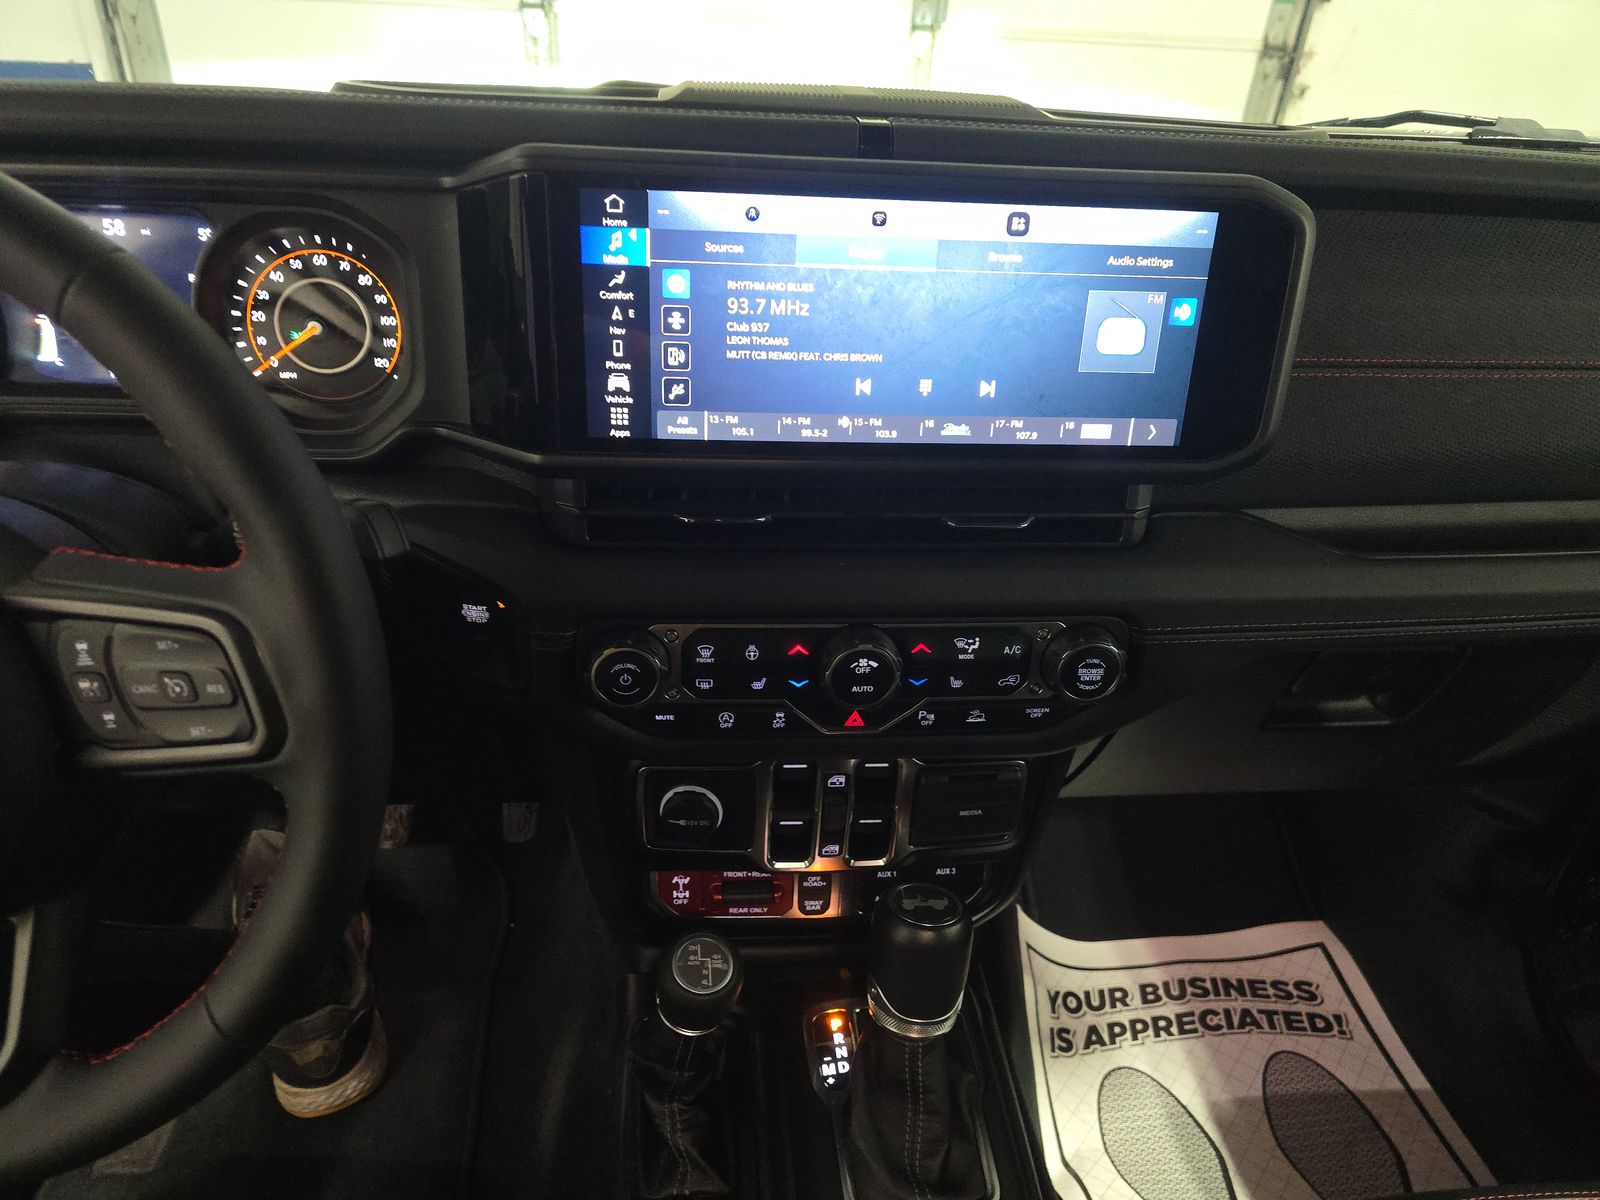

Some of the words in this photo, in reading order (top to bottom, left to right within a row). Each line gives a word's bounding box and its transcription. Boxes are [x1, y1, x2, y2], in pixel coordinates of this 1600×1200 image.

[602, 217, 628, 227] Home
[102, 218, 126, 237] 58
[704, 242, 744, 254] Sources
[288, 258, 303, 270] 50
[312, 254, 328, 266] 60
[1107, 255, 1135, 267] Audio
[1136, 256, 1174, 269] Settings
[338, 260, 351, 271] 70
[268, 270, 284, 283] 40
[358, 273, 372, 286] 80
[766, 282, 786, 292] AND
[256, 290, 270, 300] 30
[374, 294, 388, 304] 90
[599, 290, 634, 301] Comfort
[1148, 294, 1164, 304] FM
[727, 297, 766, 315] 93.7
[770, 299, 810, 317] MHz
[251, 310, 266, 322] 20
[629, 309, 635, 319] E
[380, 315, 396, 326] 100
[609, 326, 626, 336] Nav
[726, 322, 750, 332] Club
[751, 322, 770, 332] 937
[256, 336, 268, 346] 10
[383, 338, 397, 348] 110
[726, 336, 751, 345] LEON
[752, 336, 789, 346] THOMAS
[726, 350, 752, 360] MUTT
[799, 352, 822, 362] FEAT.
[823, 352, 849, 362] CHRIS
[850, 353, 883, 362] BROWN
[374, 357, 390, 368] 120
[606, 360, 632, 370] Phone
[604, 394, 634, 404] Vehicle
[708, 414, 718, 424] 13
[725, 415, 738, 424] FM
[782, 416, 792, 425] 14
[798, 416, 811, 426] FM
[854, 418, 864, 426] 15
[869, 418, 882, 427] FM
[995, 420, 1004, 429] 17
[1010, 420, 1024, 430] FM
[610, 428, 631, 438] Apps
[732, 427, 754, 436] 105.1
[874, 429, 898, 438] 103.9
[1015, 431, 1038, 440] 107.9
[462, 603, 488, 612] START
[1004, 645, 1022, 655] A/C
[614, 663, 638, 671] VOLUME
[1047, 985, 1131, 1018] YOUR
[1139, 975, 1324, 1007] BUSINESS
[830, 1018, 842, 1031] P
[1049, 1026, 1079, 1057] IS
[1082, 1008, 1353, 1053] APPRECIATED!
[833, 1032, 845, 1044] R
[835, 1046, 848, 1058] N
[822, 1063, 836, 1076] M
[838, 1061, 850, 1074] D
